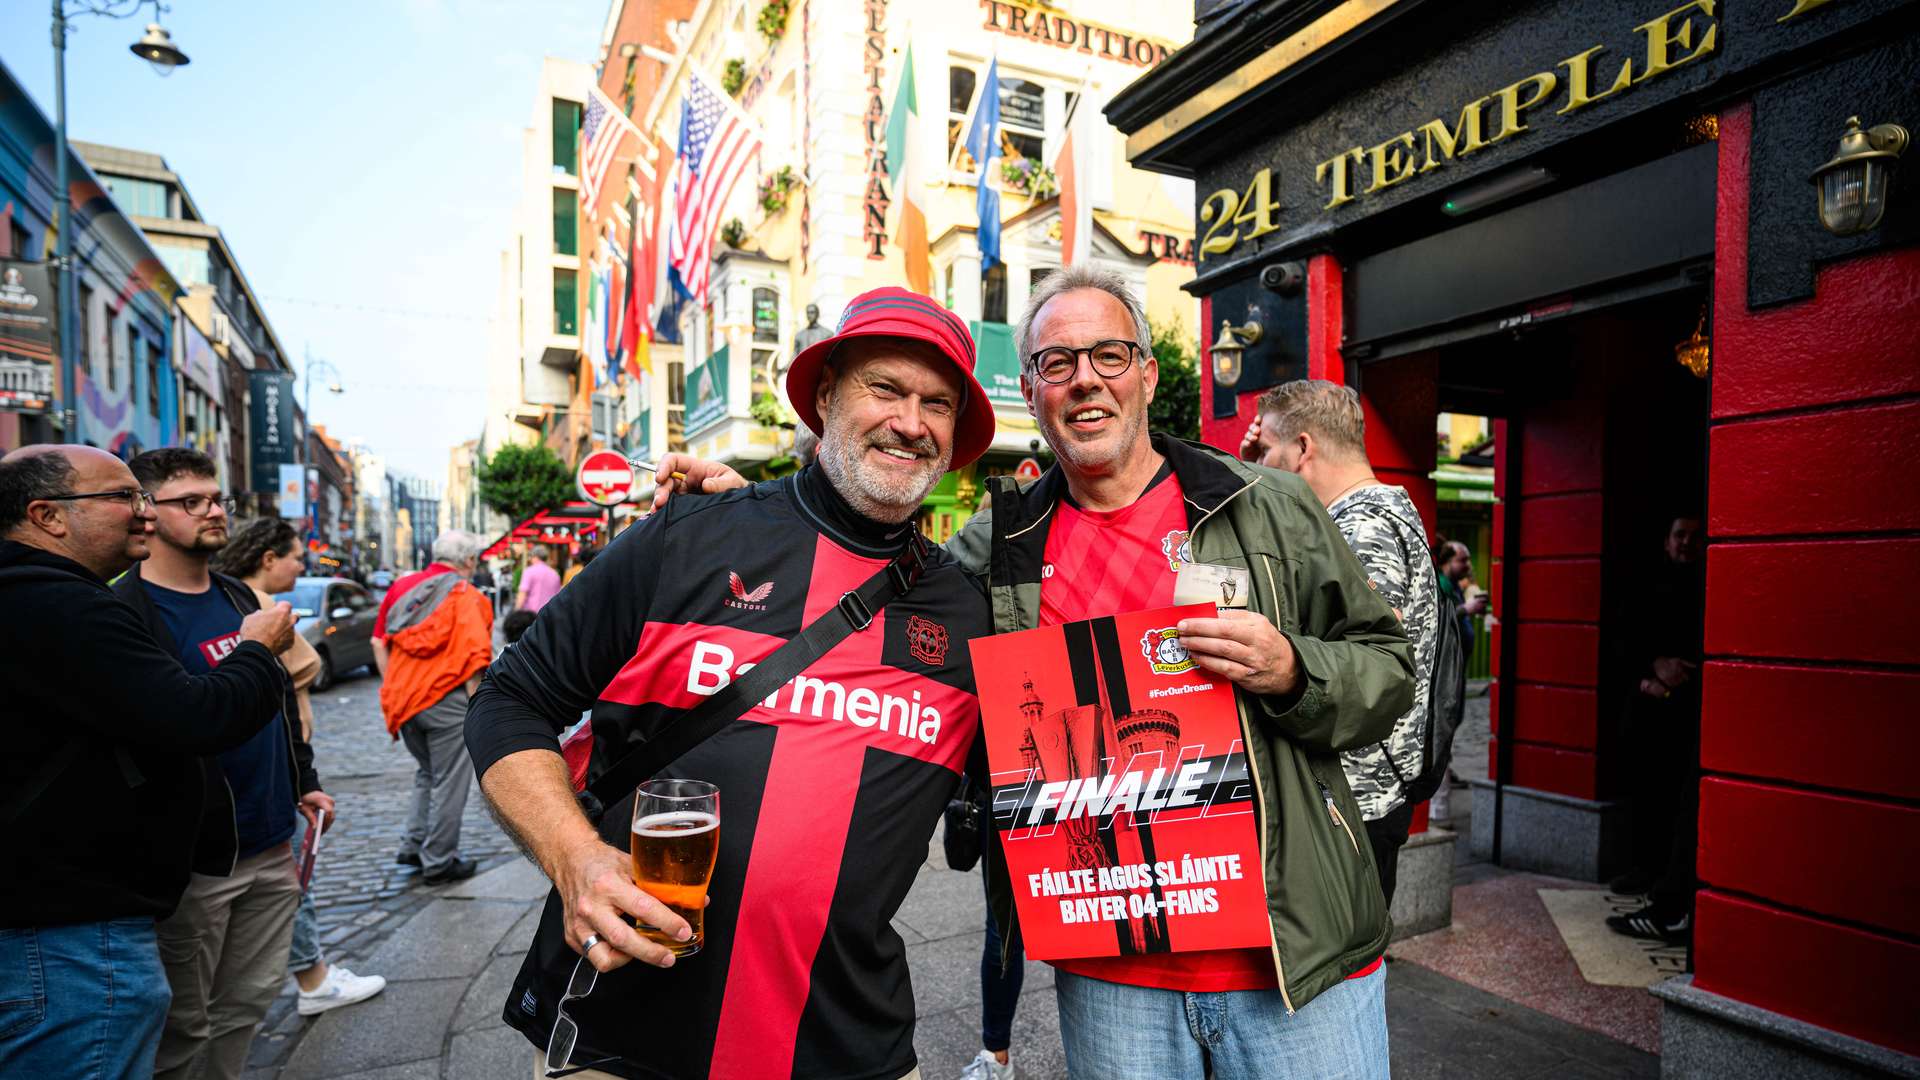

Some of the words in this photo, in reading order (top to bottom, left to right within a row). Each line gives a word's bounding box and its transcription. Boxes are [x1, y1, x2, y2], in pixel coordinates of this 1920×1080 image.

[864, 0, 890, 260] ESTAURANT
[1199, 167, 1280, 262] 24
[1316, 0, 1717, 210] TEMPLE
[724, 599, 767, 611] CASTORE
[687, 640, 942, 745] Bmenia
[1149, 683, 1213, 699] #ForOurDream
[1026, 761, 1212, 825] FINALE
[1028, 868, 1096, 897] FÁILTE
[1096, 863, 1152, 891] AGUS
[1154, 854, 1243, 886] SLÁINTE
[1059, 896, 1128, 924] BAYER
[1128, 888, 1220, 920] 04-FANS
